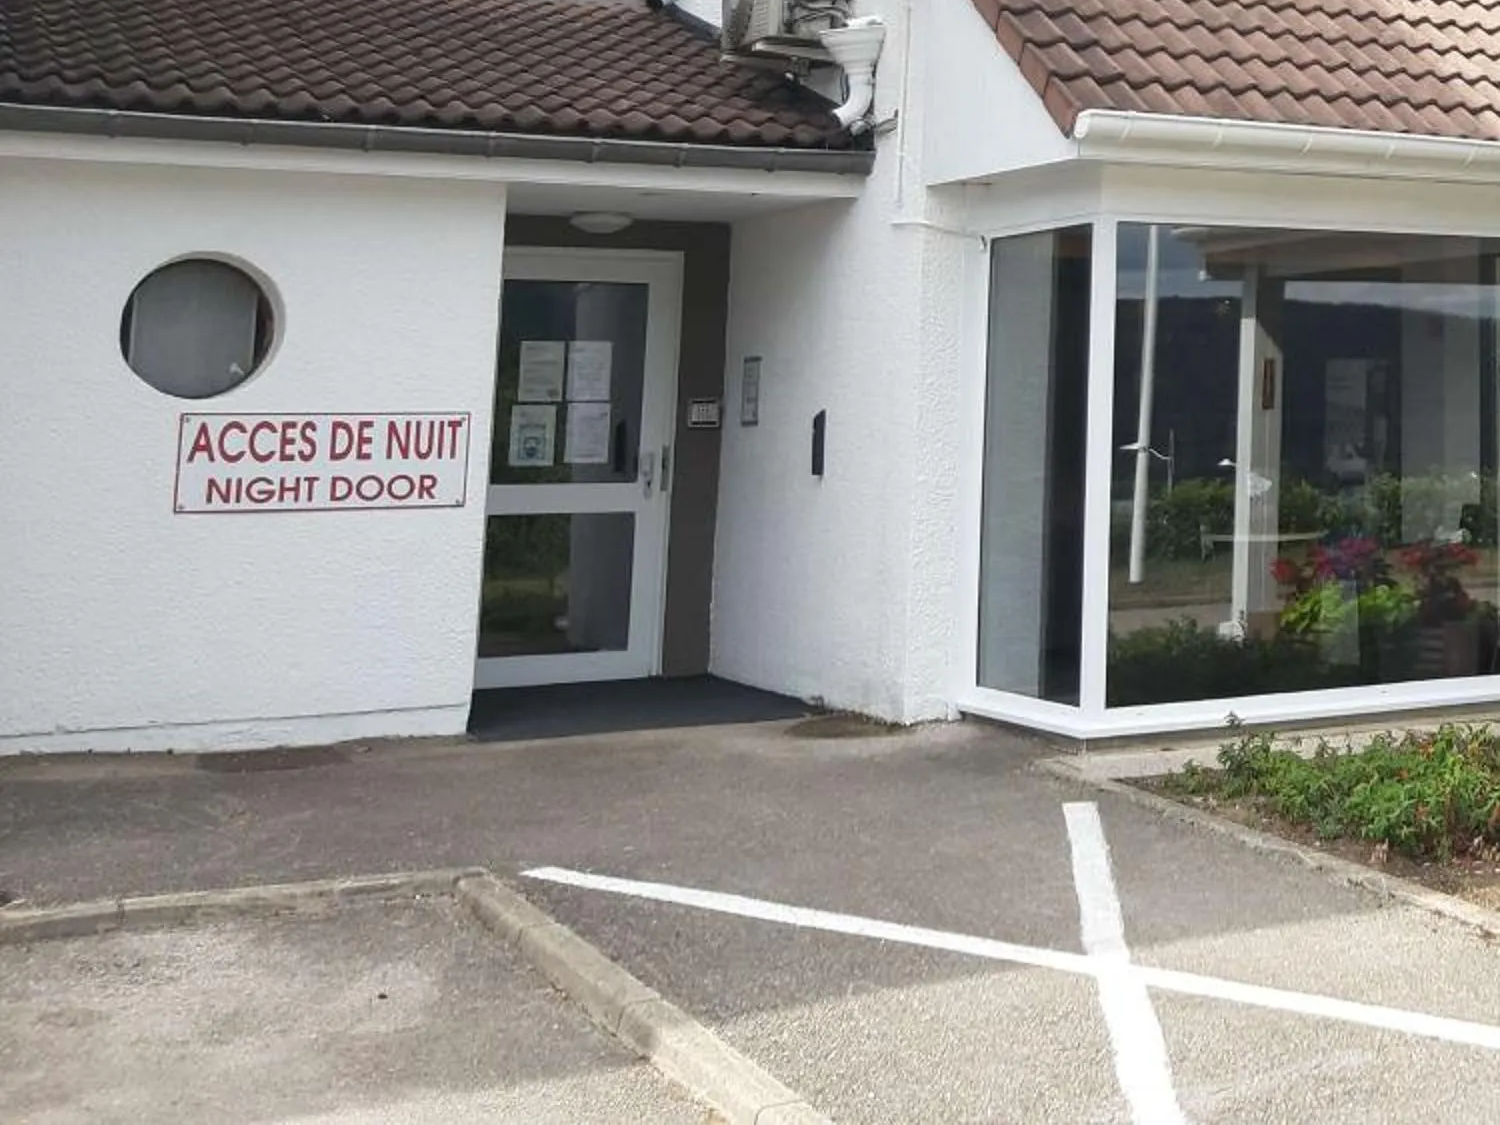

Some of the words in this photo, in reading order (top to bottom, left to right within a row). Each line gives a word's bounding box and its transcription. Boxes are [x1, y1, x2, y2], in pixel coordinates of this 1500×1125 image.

[187, 421, 317, 464] ACCES
[329, 420, 374, 460] DE
[386, 420, 462, 460] NUIT
[205, 476, 320, 504] NIGHT
[329, 474, 438, 502] DOOR
